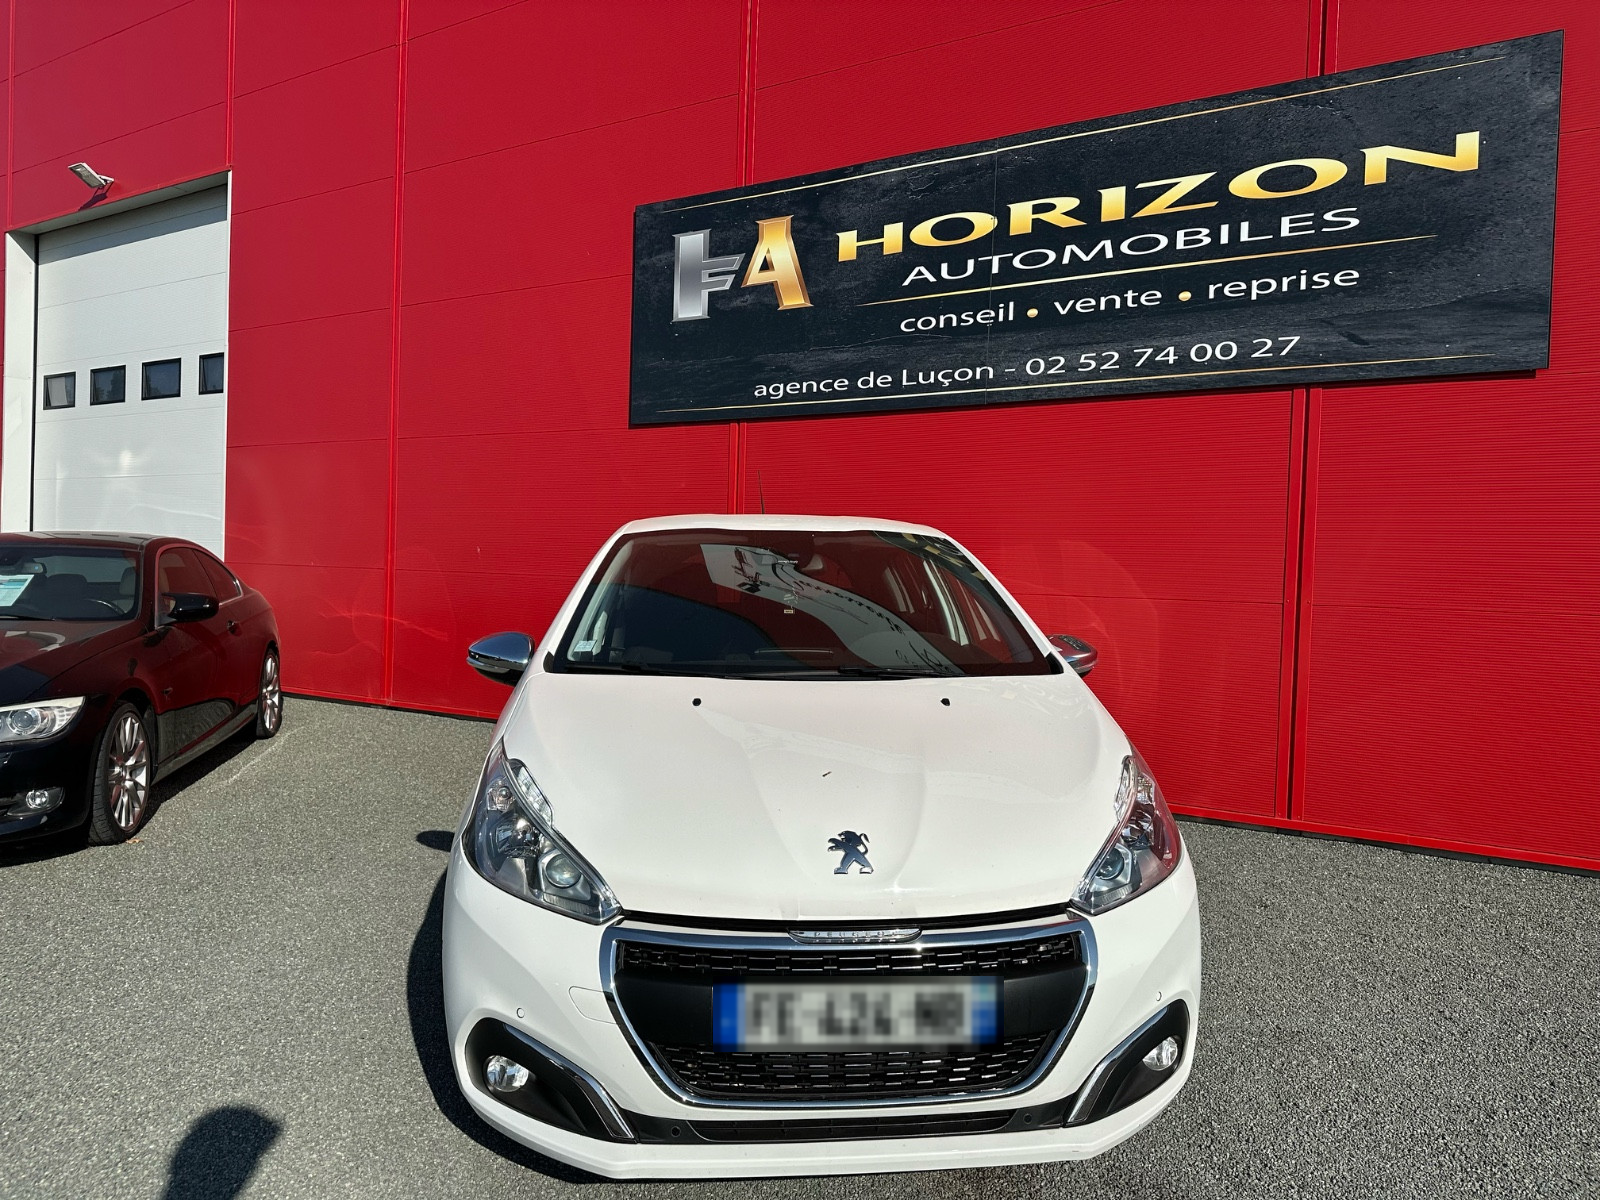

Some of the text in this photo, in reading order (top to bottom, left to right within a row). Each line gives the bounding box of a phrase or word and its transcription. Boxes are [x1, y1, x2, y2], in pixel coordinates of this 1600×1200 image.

[836, 131, 1480, 263] HORIZON
[901, 207, 1360, 287] AUTOMOBILES
[900, 269, 1360, 333] conseil vente reprise
[754, 376, 849, 400] agence
[857, 371, 893, 389] de
[902, 365, 994, 387] Luçon
[1025, 355, 1066, 376] 02
[1077, 351, 1120, 372] 52
[1133, 346, 1179, 367] 74
[1189, 340, 1238, 363] 00
[1250, 335, 1301, 358] 27
